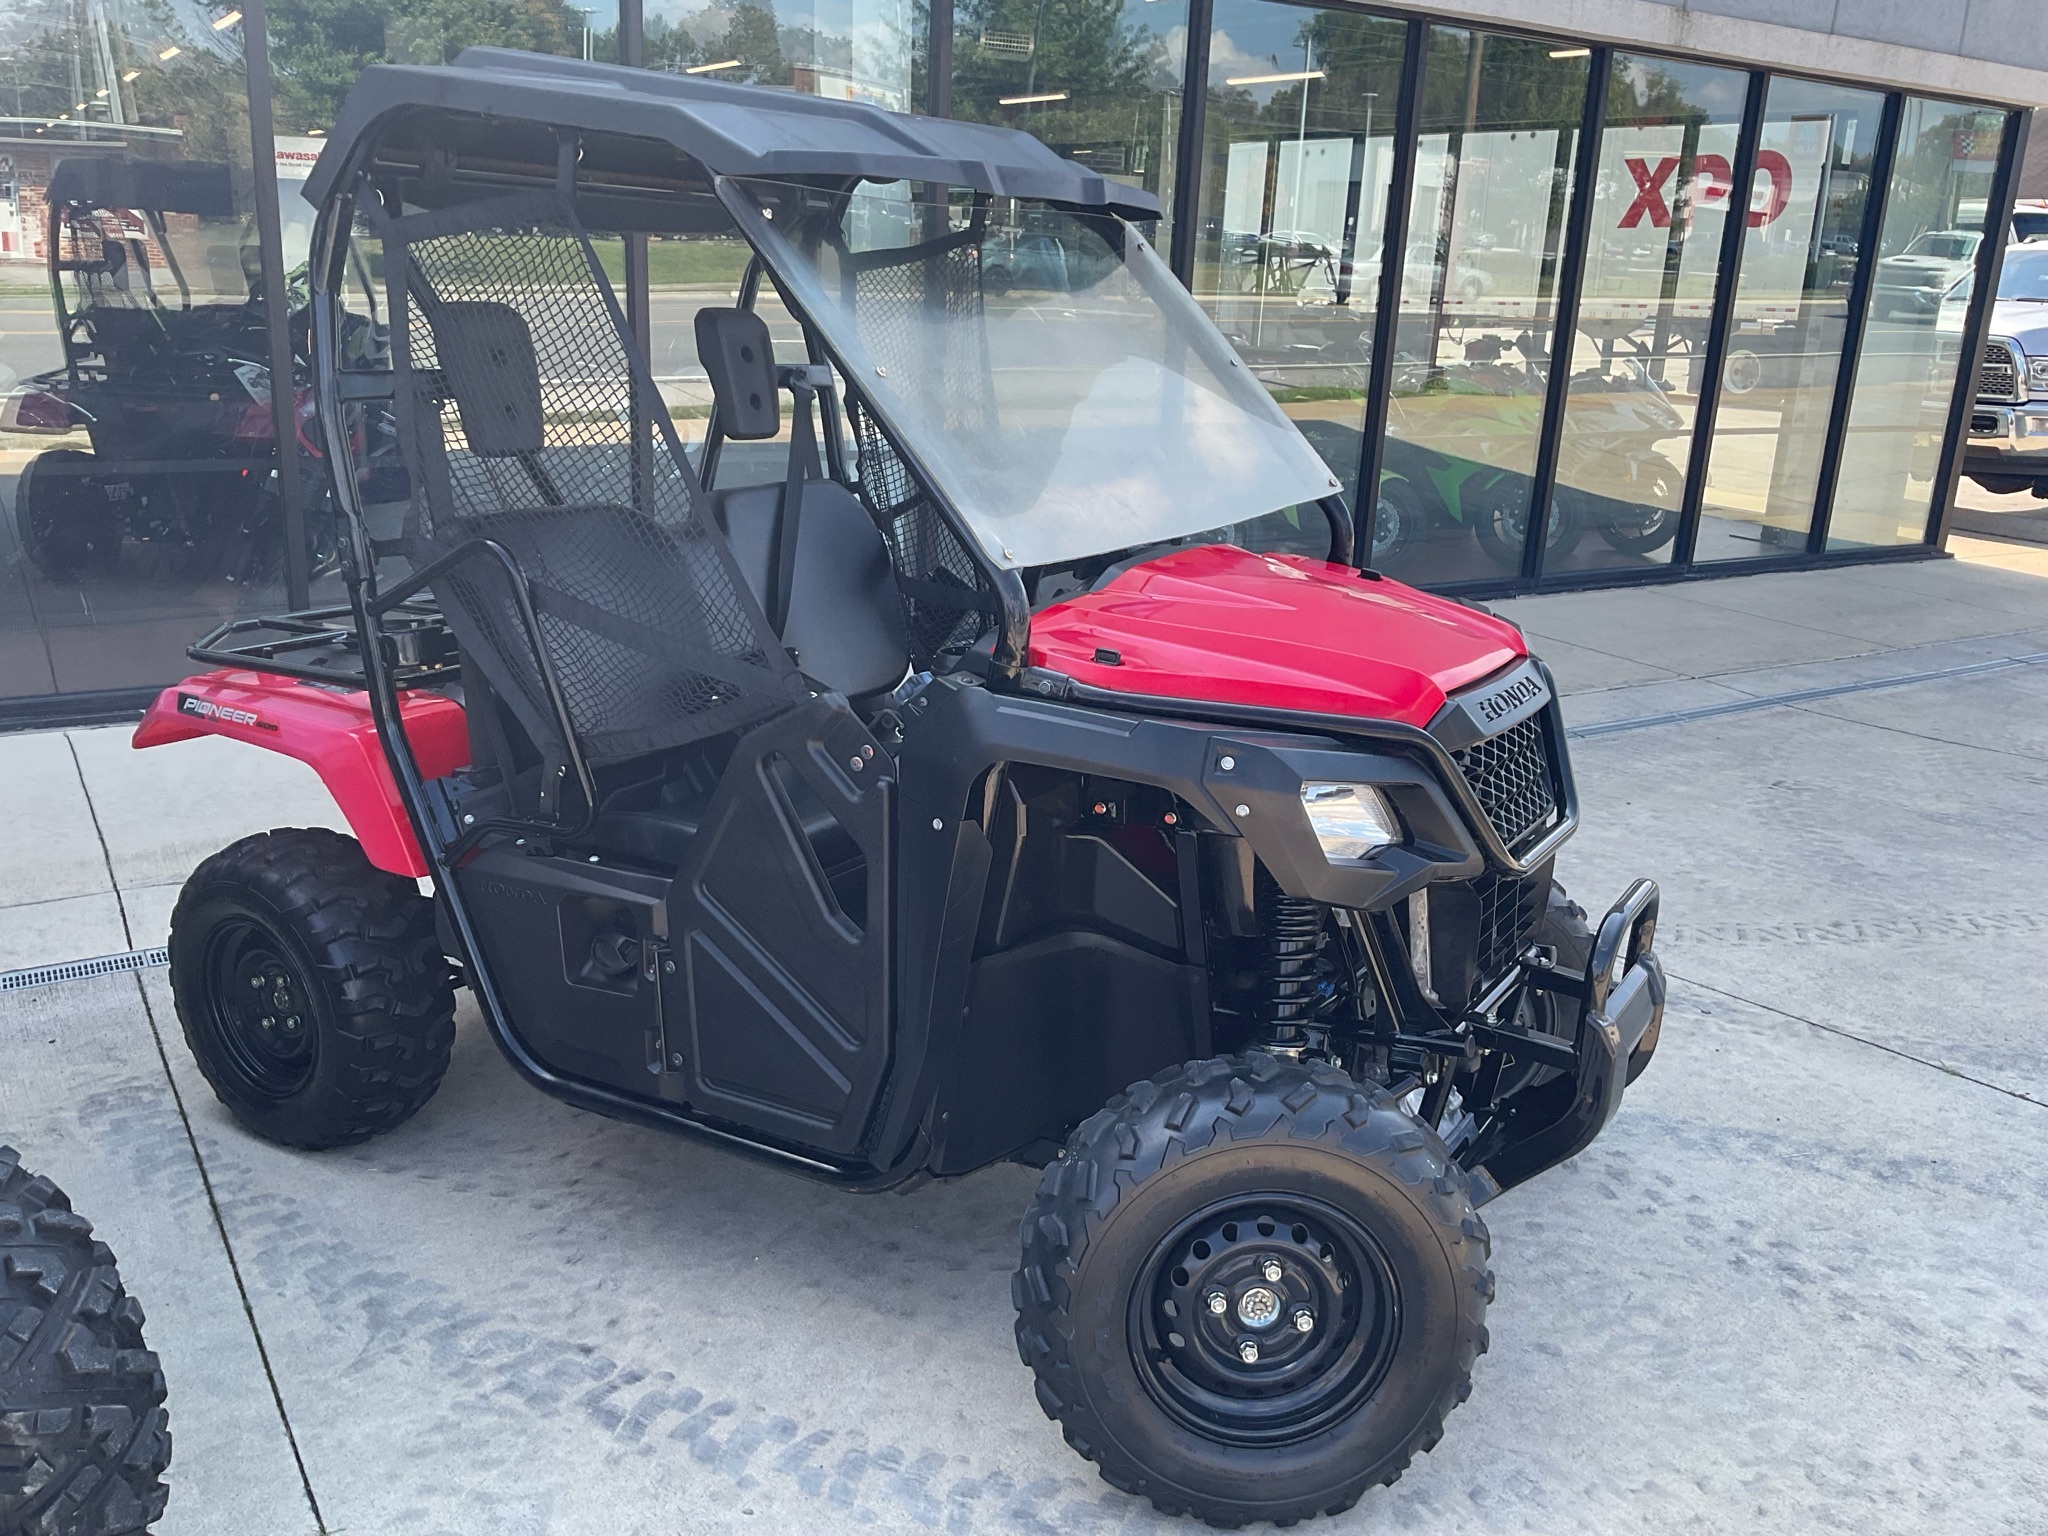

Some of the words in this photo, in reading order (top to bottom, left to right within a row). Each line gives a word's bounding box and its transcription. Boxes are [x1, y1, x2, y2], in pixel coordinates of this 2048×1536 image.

[275, 150, 320, 161] awasa
[1617, 149, 1792, 228] XPO
[183, 697, 258, 726] PIONEER
[1476, 675, 1543, 723] HONDA
